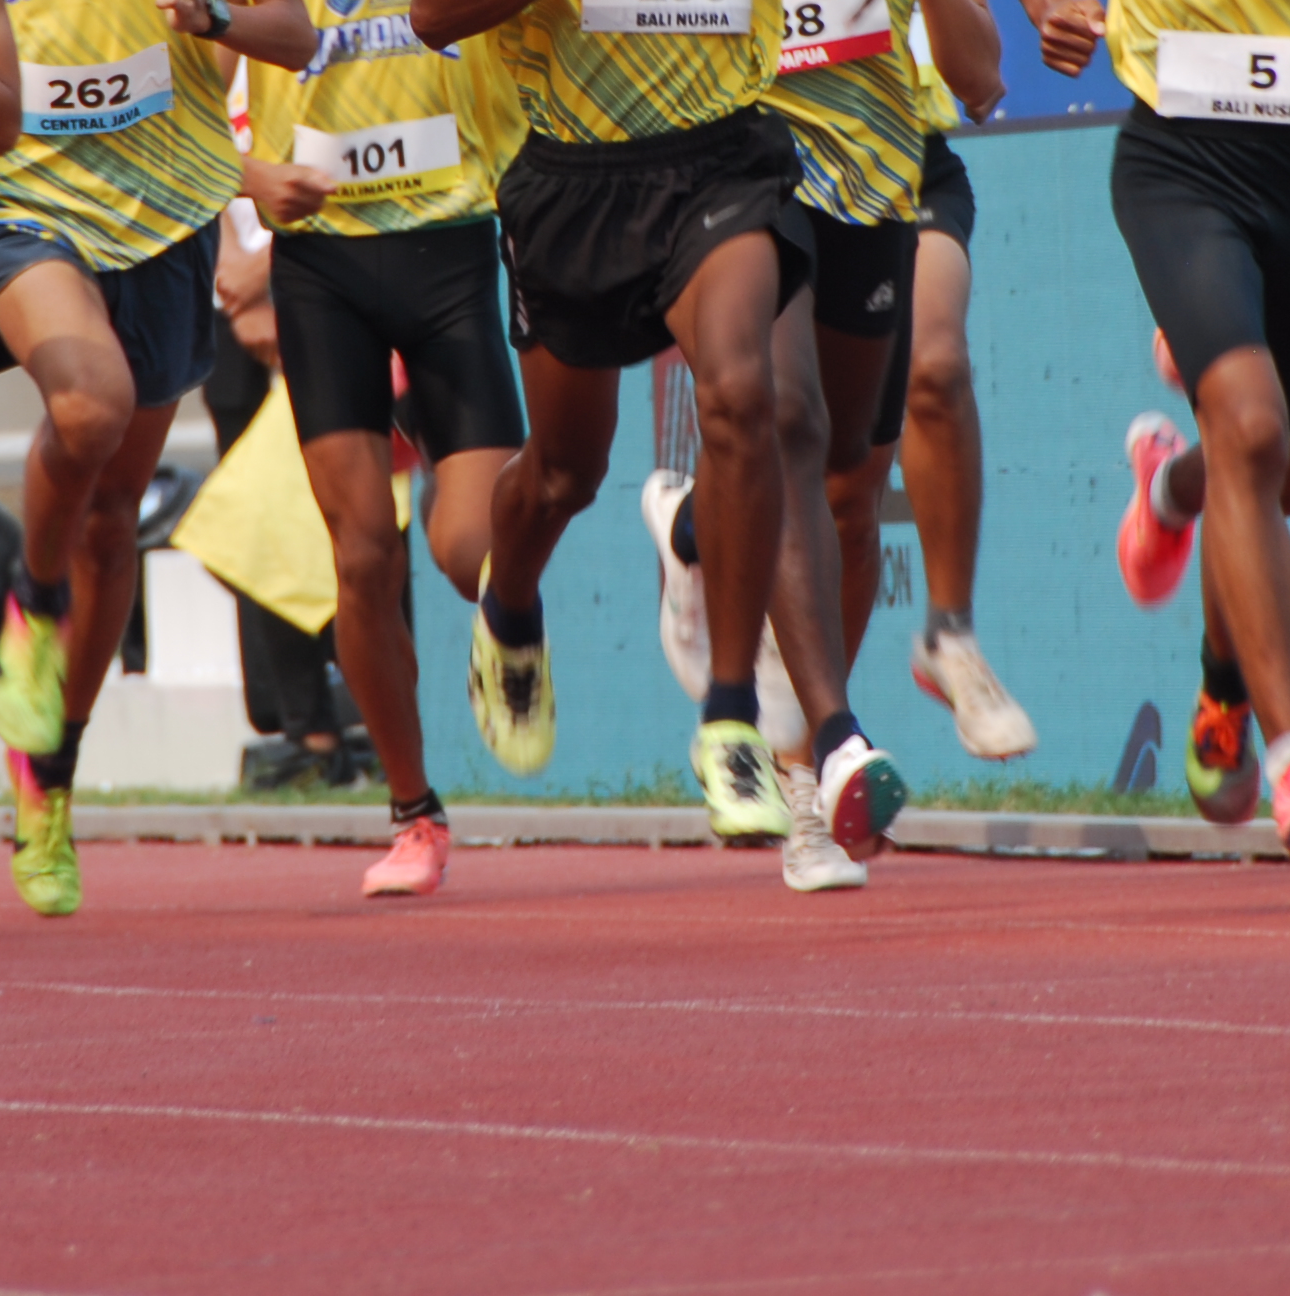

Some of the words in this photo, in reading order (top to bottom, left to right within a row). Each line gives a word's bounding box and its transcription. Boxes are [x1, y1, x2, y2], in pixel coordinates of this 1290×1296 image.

[636, 12, 672, 27] BALI
[676, 12, 730, 27] NUSRA
[1249, 53, 1278, 90] 5
[47, 73, 131, 110] 262
[1211, 99, 1249, 115] BALI
[40, 117, 107, 131] CENTRAL
[111, 106, 142, 128] JAVA
[341, 137, 406, 177] 101
